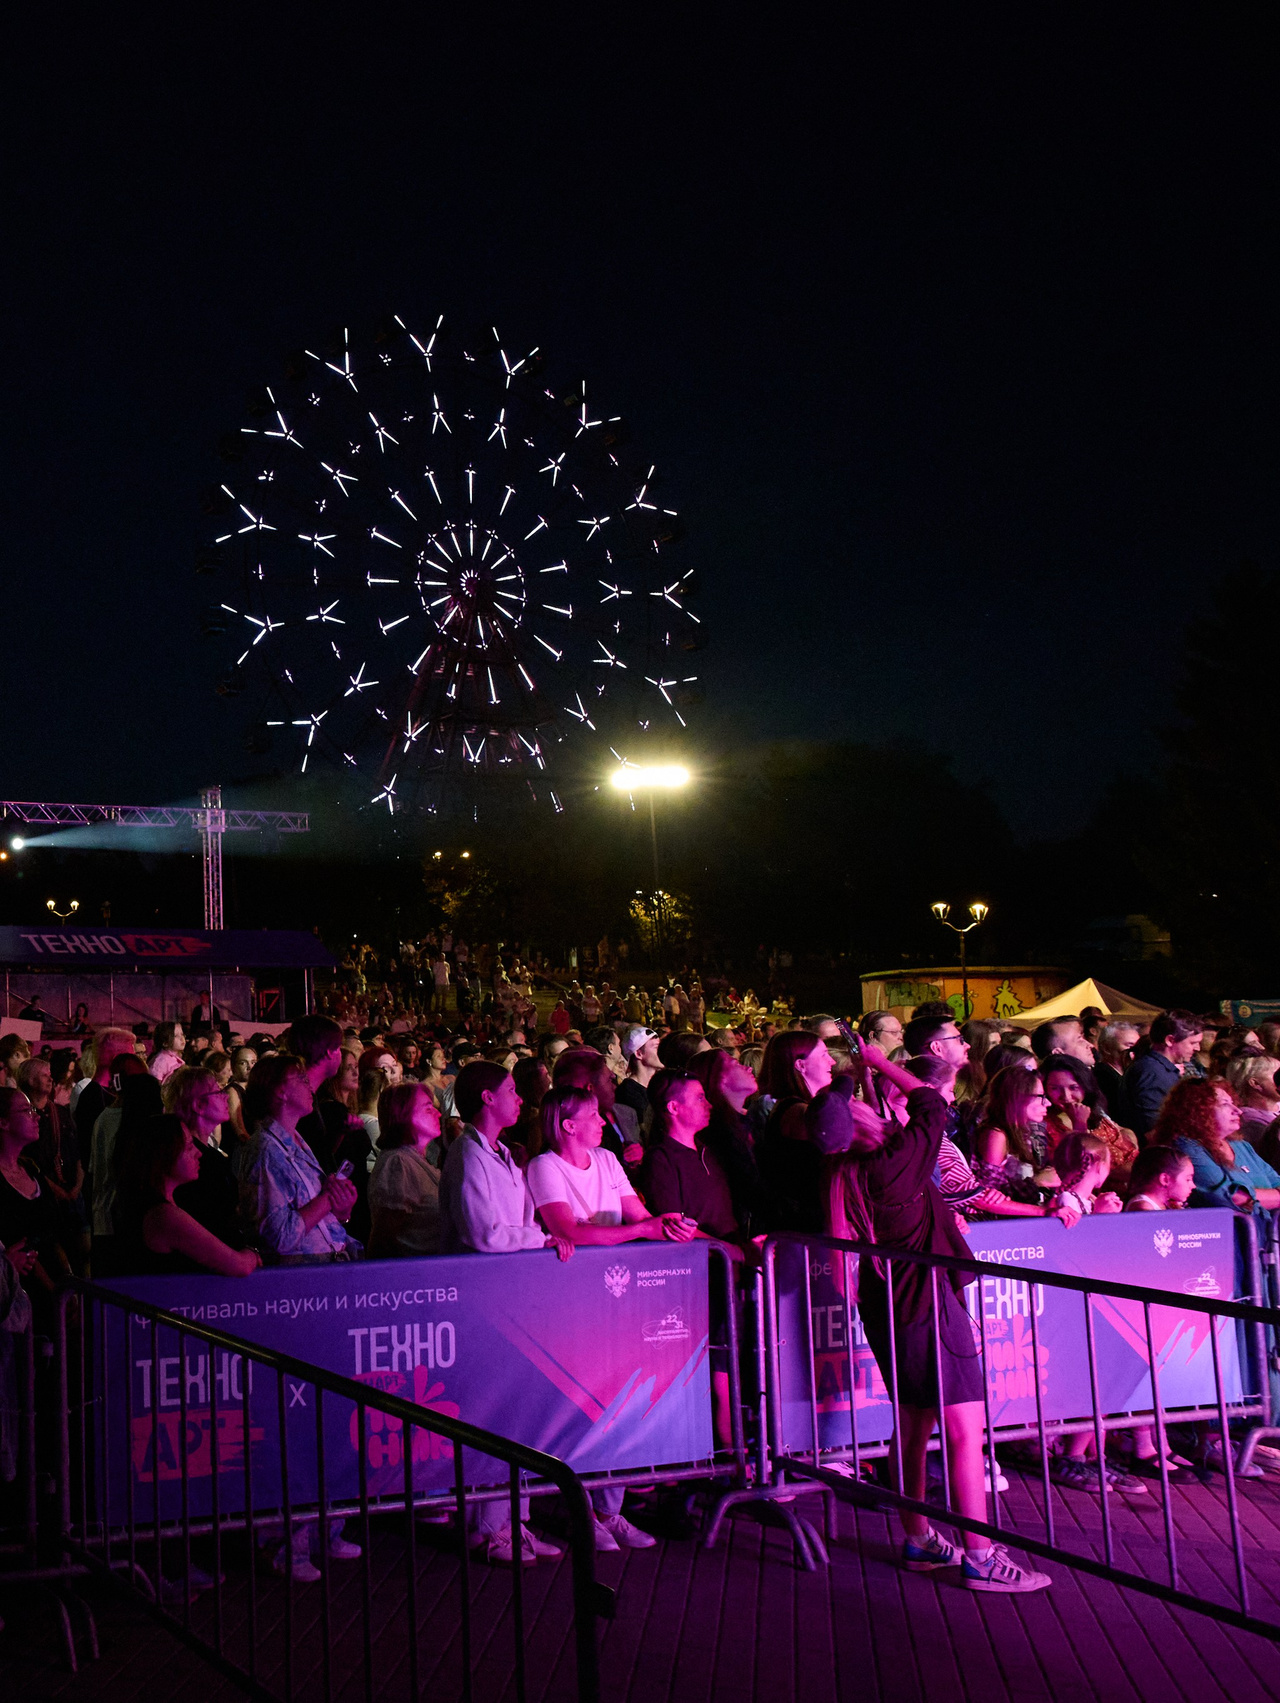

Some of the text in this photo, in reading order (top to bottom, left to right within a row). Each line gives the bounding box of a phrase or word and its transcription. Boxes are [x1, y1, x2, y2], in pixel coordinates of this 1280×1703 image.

[20, 934, 126, 955] ТЕХНО
[637, 1268, 692, 1279] МИНОБРНАУКИ
[637, 1279, 666, 1288] РОССИИ
[135, 1287, 458, 1330] тиваль науки и искусства
[810, 1305, 869, 1348] ТЕХ
[347, 1321, 456, 1376] ТЕХНО
[135, 1352, 253, 1409] ТЕХНО
